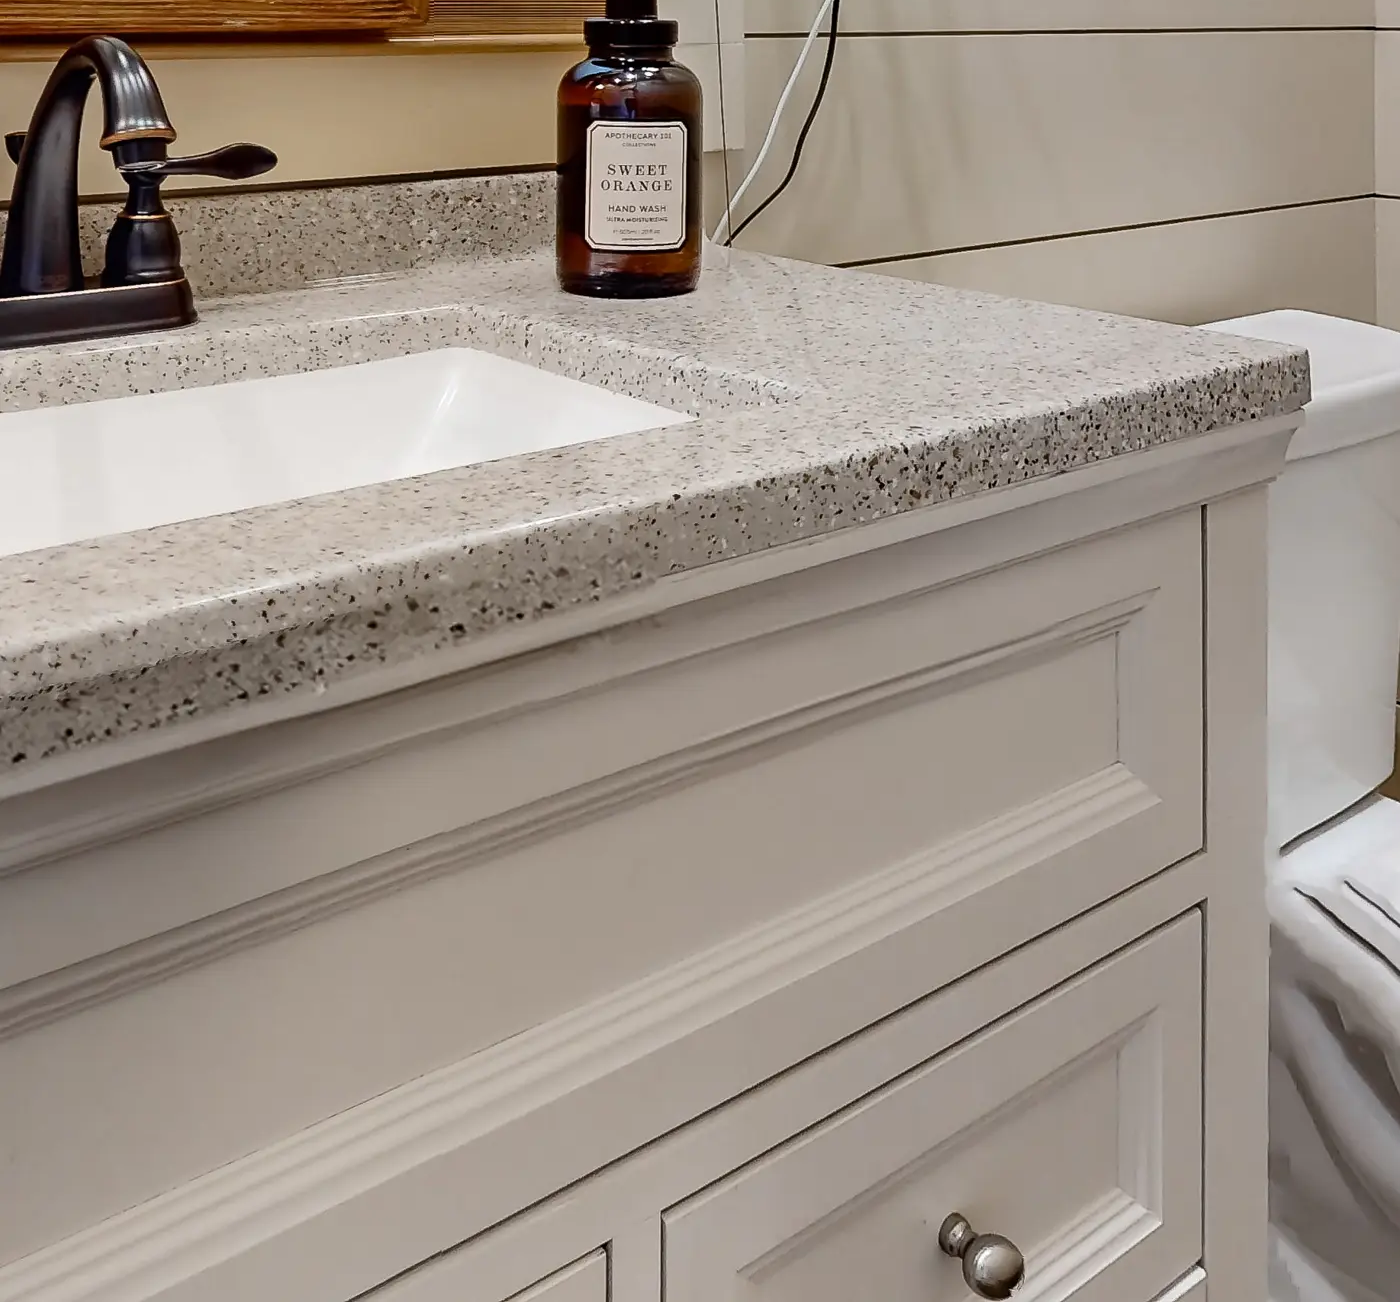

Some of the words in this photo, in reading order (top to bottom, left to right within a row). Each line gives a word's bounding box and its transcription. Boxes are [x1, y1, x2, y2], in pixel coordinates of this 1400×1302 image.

[604, 132, 658, 140] APOTHECARY
[607, 164, 668, 176] SWEET
[600, 179, 673, 192] ORANGE
[608, 204, 637, 213] HAND
[639, 204, 667, 213] WASH
